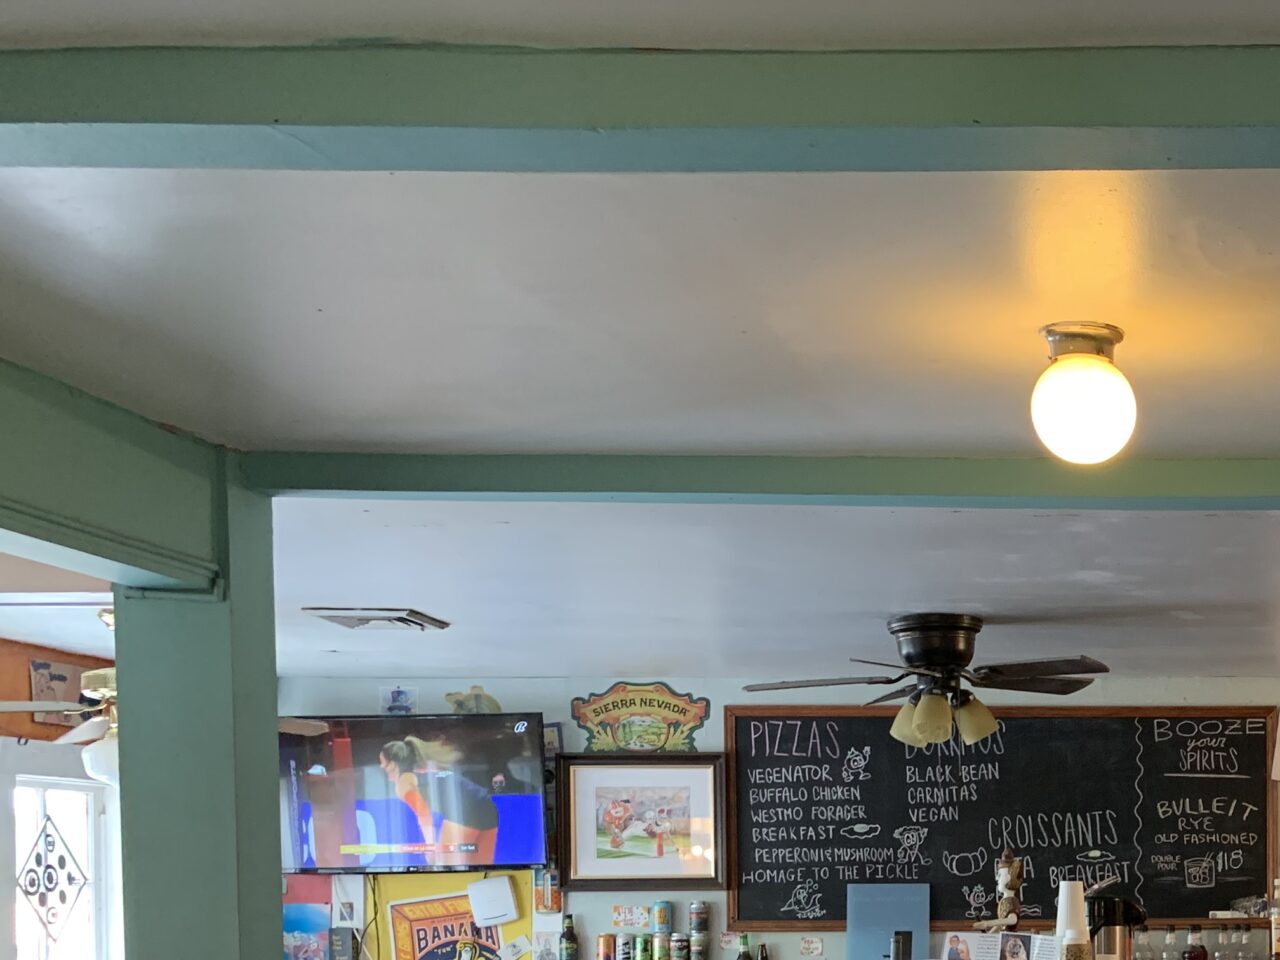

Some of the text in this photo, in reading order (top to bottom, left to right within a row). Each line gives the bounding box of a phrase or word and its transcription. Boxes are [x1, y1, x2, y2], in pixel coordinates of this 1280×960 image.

[592, 697, 689, 718] SIERRA NEVADA
[751, 720, 840, 758] PIZZAS
[1154, 719, 1267, 742] BOOZE
[1187, 736, 1227, 751] your
[1180, 748, 1239, 773] SPIRITS
[747, 764, 833, 783] VEGENATOR
[906, 761, 1000, 783] BLACK BEAN
[749, 785, 860, 805] BUFFALO CHICKEN
[908, 783, 978, 805] CARNITAS
[751, 805, 867, 823] WESTMO FORAGER
[908, 805, 959, 822] VEGAN
[1157, 797, 1259, 821] BULLEIT
[752, 826, 836, 843] BREAKFAST
[988, 810, 1118, 850] CROISSANTS
[1178, 817, 1216, 832] RYE
[1155, 833, 1258, 846] OLD FASHIONED
[755, 848, 824, 863] PEPPERONI
[834, 847, 894, 863] MUSHROOM
[1151, 854, 1181, 864] DOUBLE
[1216, 850, 1244, 873] $18
[742, 863, 919, 884] HOMAGE TO THE PICKLE
[1157, 862, 1178, 871] POUR
[416, 920, 496, 953] BANANA
